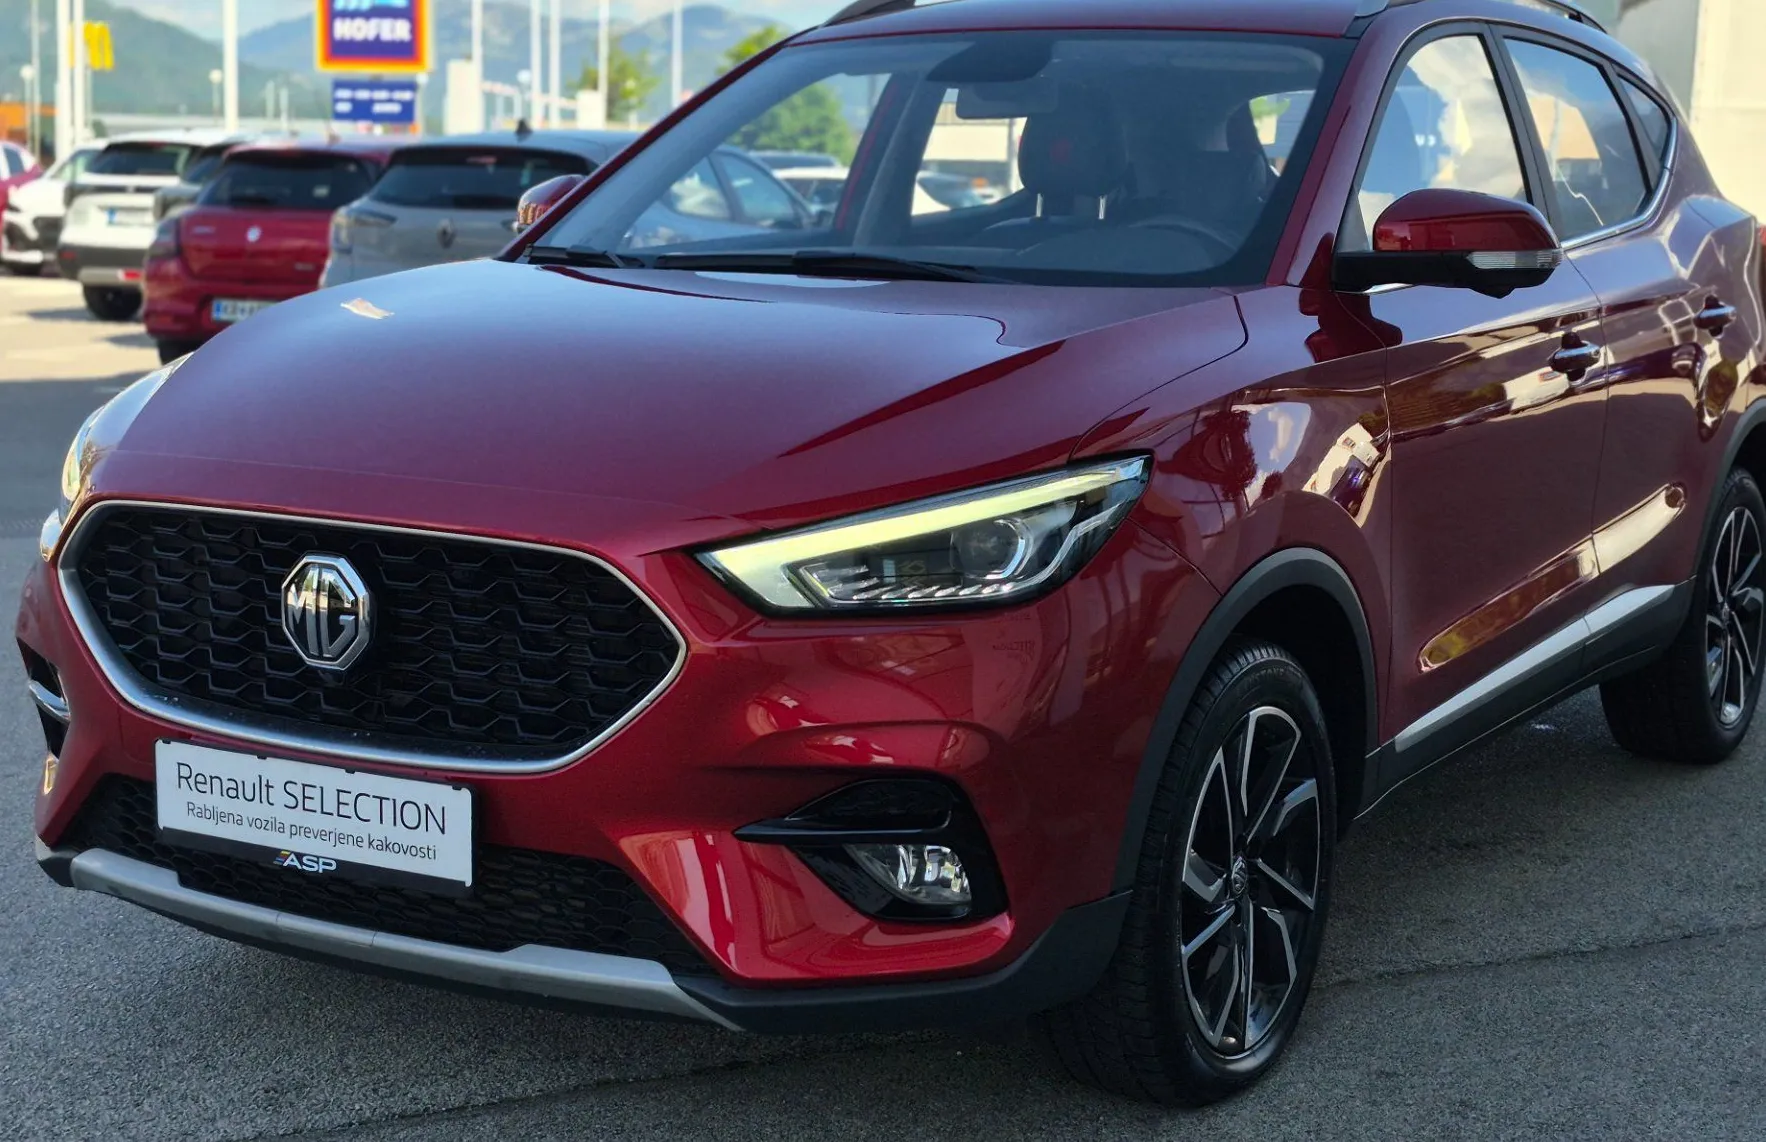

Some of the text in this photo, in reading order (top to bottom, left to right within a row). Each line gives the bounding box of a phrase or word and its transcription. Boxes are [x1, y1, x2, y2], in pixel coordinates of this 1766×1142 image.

[333, 17, 412, 41] HOFER
[286, 565, 356, 658] MG
[176, 761, 446, 835] Renault SELECTION
[187, 801, 437, 860] Rabljena vozila preverjene kakovosti
[283, 853, 337, 873] ASP
